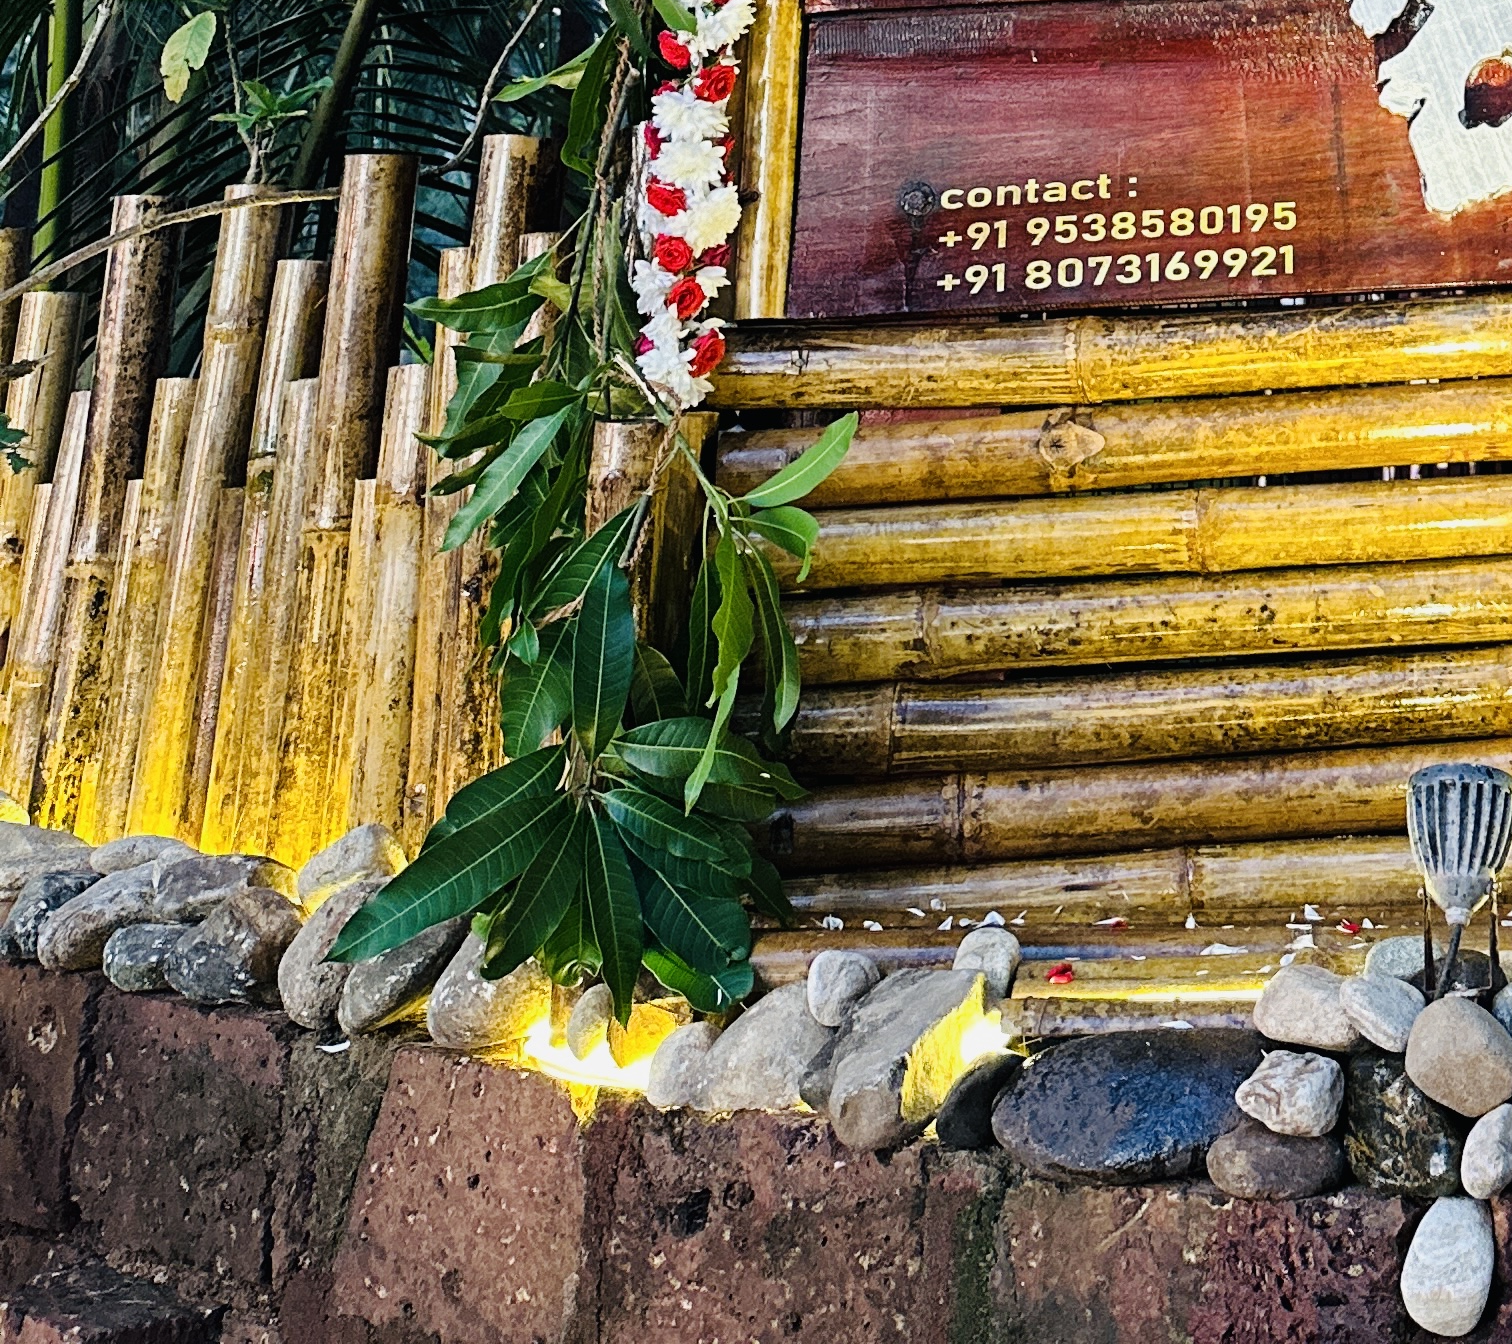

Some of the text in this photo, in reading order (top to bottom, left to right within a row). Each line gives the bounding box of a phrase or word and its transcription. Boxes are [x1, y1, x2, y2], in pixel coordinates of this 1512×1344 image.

[939, 172, 1112, 211] contact
[937, 200, 1298, 252] +91 9538580195
[935, 243, 1296, 296] +91 8073169921
